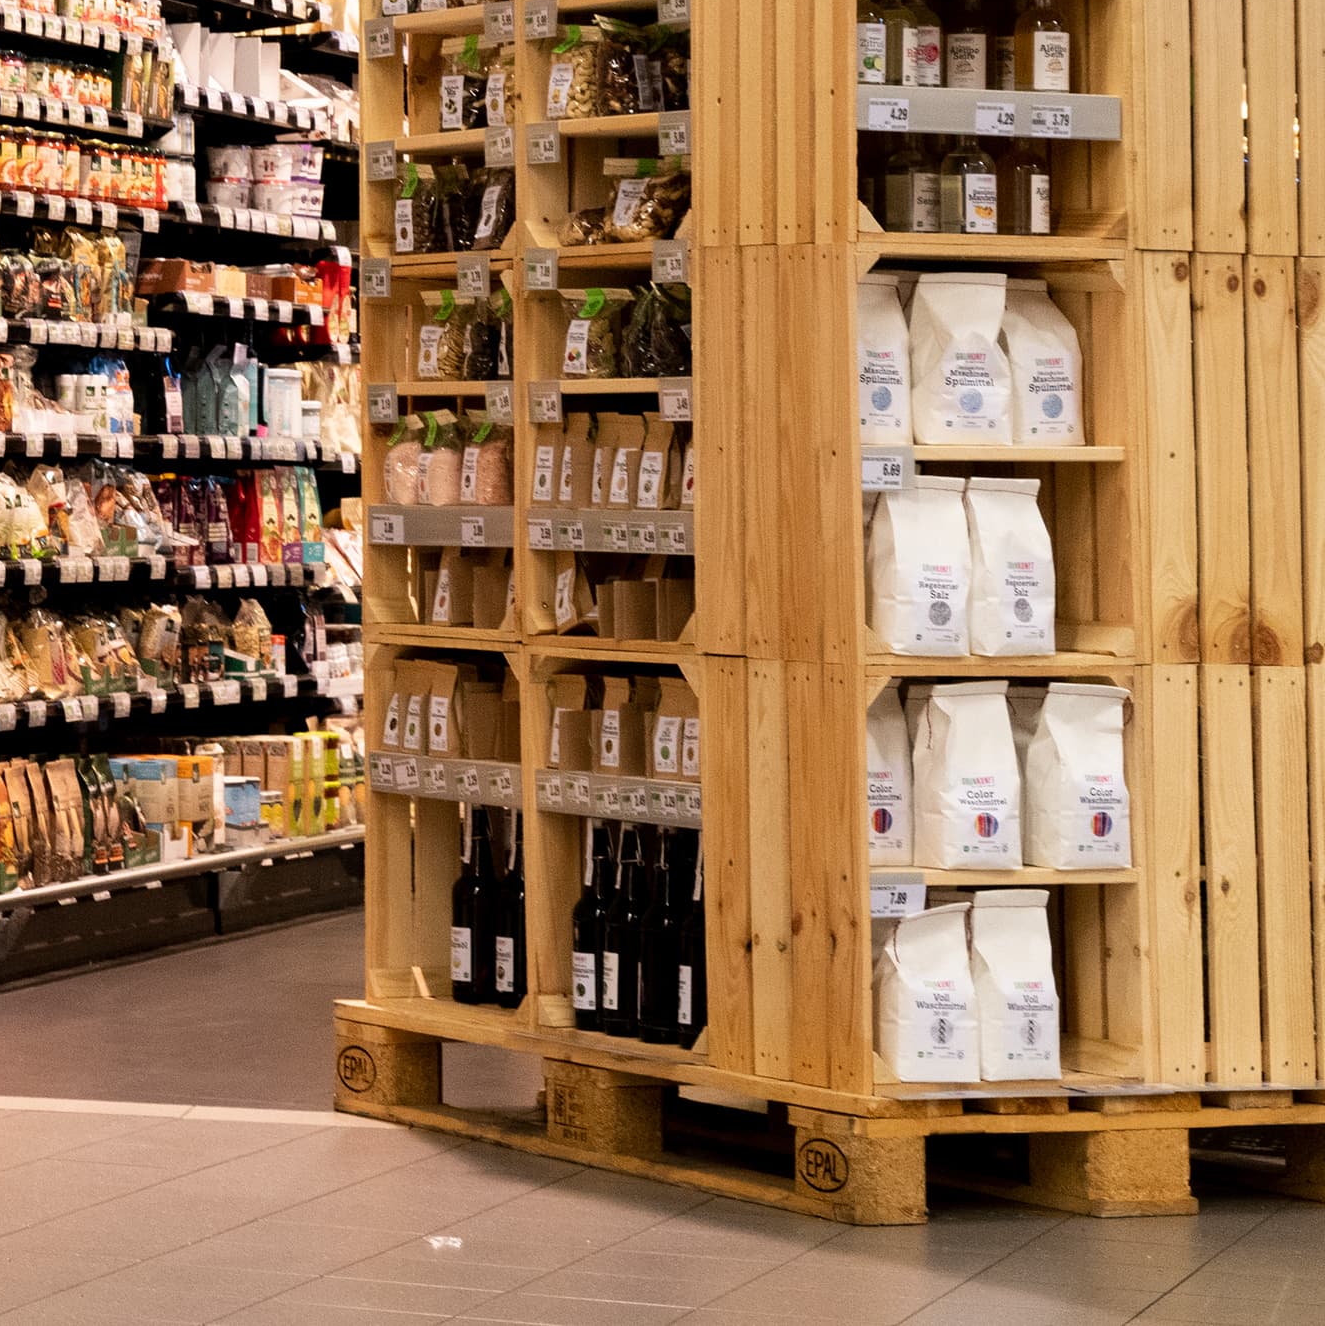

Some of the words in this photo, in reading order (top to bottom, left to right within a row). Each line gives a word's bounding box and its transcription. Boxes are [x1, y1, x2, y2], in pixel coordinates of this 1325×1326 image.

[891, 108, 907, 121] 4.29
[998, 113, 1014, 125] 4.29
[1053, 114, 1069, 126] 3.79
[860, 374, 903, 386] Spülmittel
[945, 376, 994, 387] Spülmittel
[1029, 382, 1073, 393] Spülmittel
[883, 463, 900, 476] 6.69
[930, 590, 949, 600] Salz
[1014, 587, 1029, 597] Salz
[870, 785, 893, 794] Color
[1090, 787, 1113, 797] Color
[867, 793, 903, 802] aschmittel
[967, 790, 994, 800] Color
[959, 798, 1007, 806] Waschmittel
[1080, 796, 1123, 805] Waschmittel
[933, 994, 950, 1002] Voll
[1023, 994, 1038, 1004] Voll
[916, 1001, 967, 1010] Waschmittel
[1008, 1003, 1053, 1012] Waschmittel
[804, 1149, 842, 1183] EPAL
